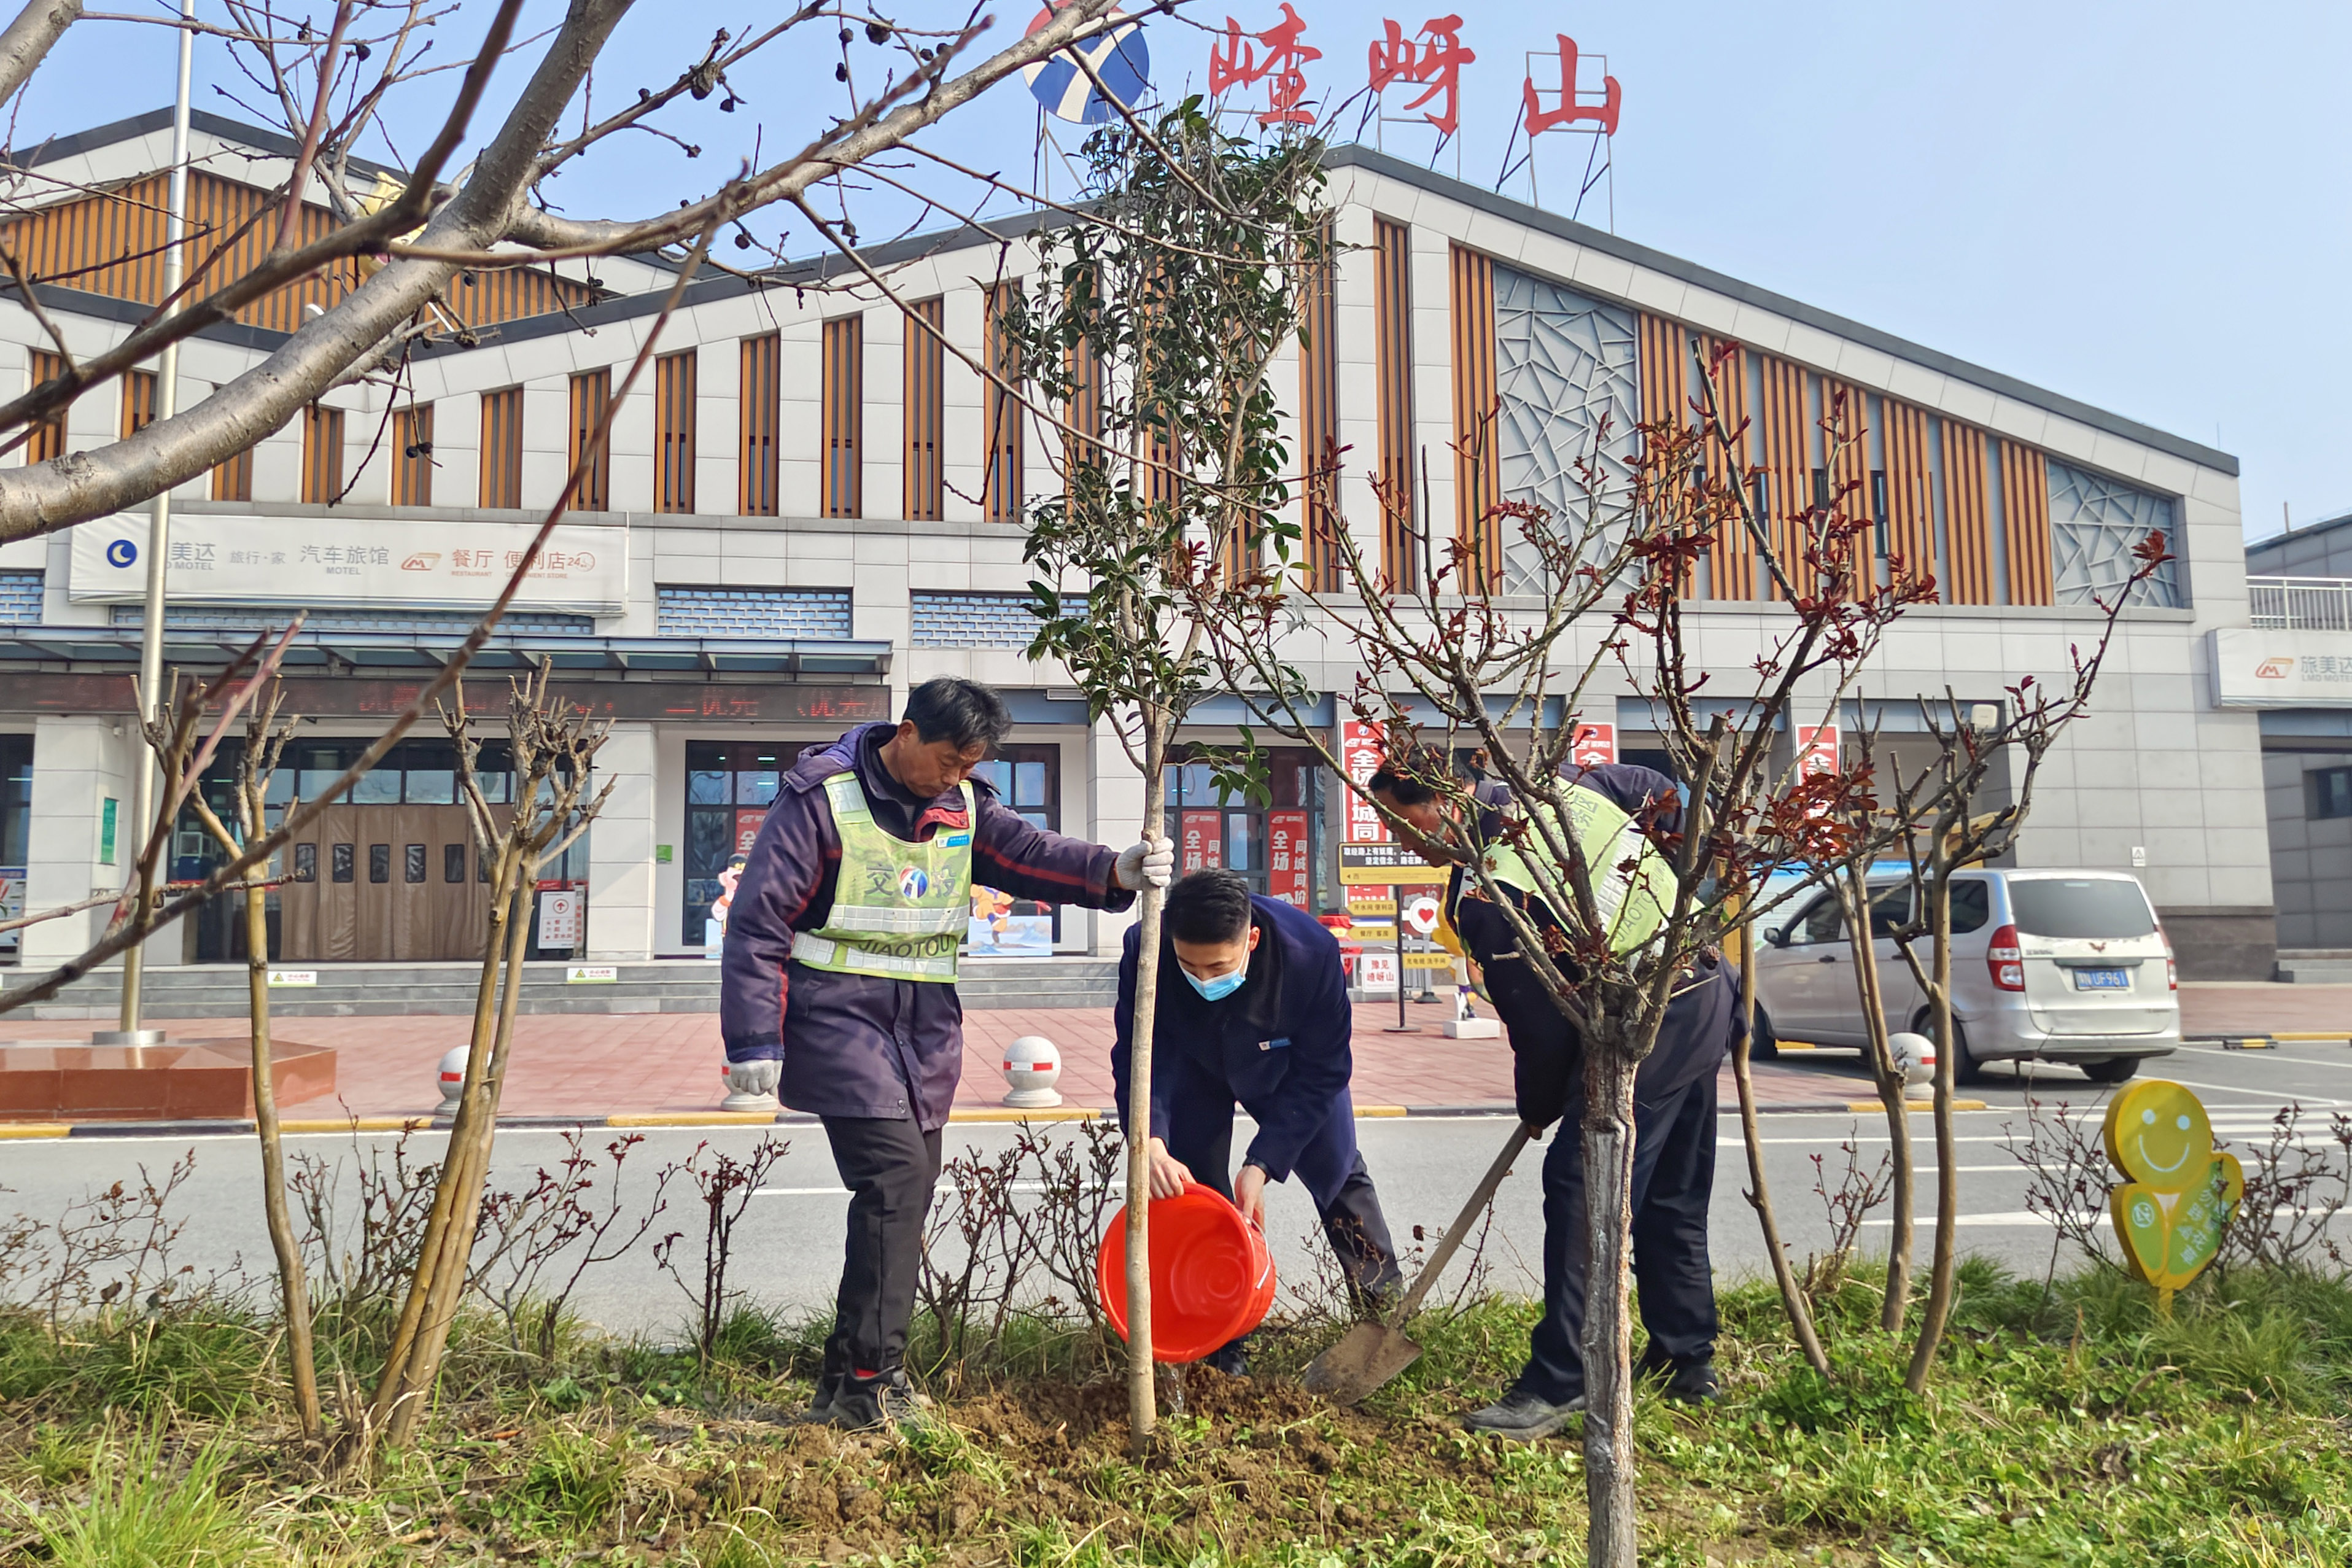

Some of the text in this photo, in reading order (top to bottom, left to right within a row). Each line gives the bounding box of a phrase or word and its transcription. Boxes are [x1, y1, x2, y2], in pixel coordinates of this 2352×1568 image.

[1209, 2, 1621, 137] 嵖岈山
[171, 541, 216, 561] 美达
[300, 545, 390, 565] 汽车旅馆
[452, 549, 494, 568] 餐厅
[504, 550, 566, 570] 便利店
[175, 561, 214, 570] MOTEL
[327, 566, 362, 575] MOTEL
[2300, 656, 2352, 674] 旅美达
[1185, 830, 1202, 871] 全场
[1272, 831, 1289, 871] 全场
[864, 863, 960, 898] 交 投
[1294, 840, 1308, 905] 同城同价
[858, 934, 950, 958] JIAOTOU
[1371, 960, 1389, 969] 豫见
[1367, 972, 1394, 982] 嵖岈山
